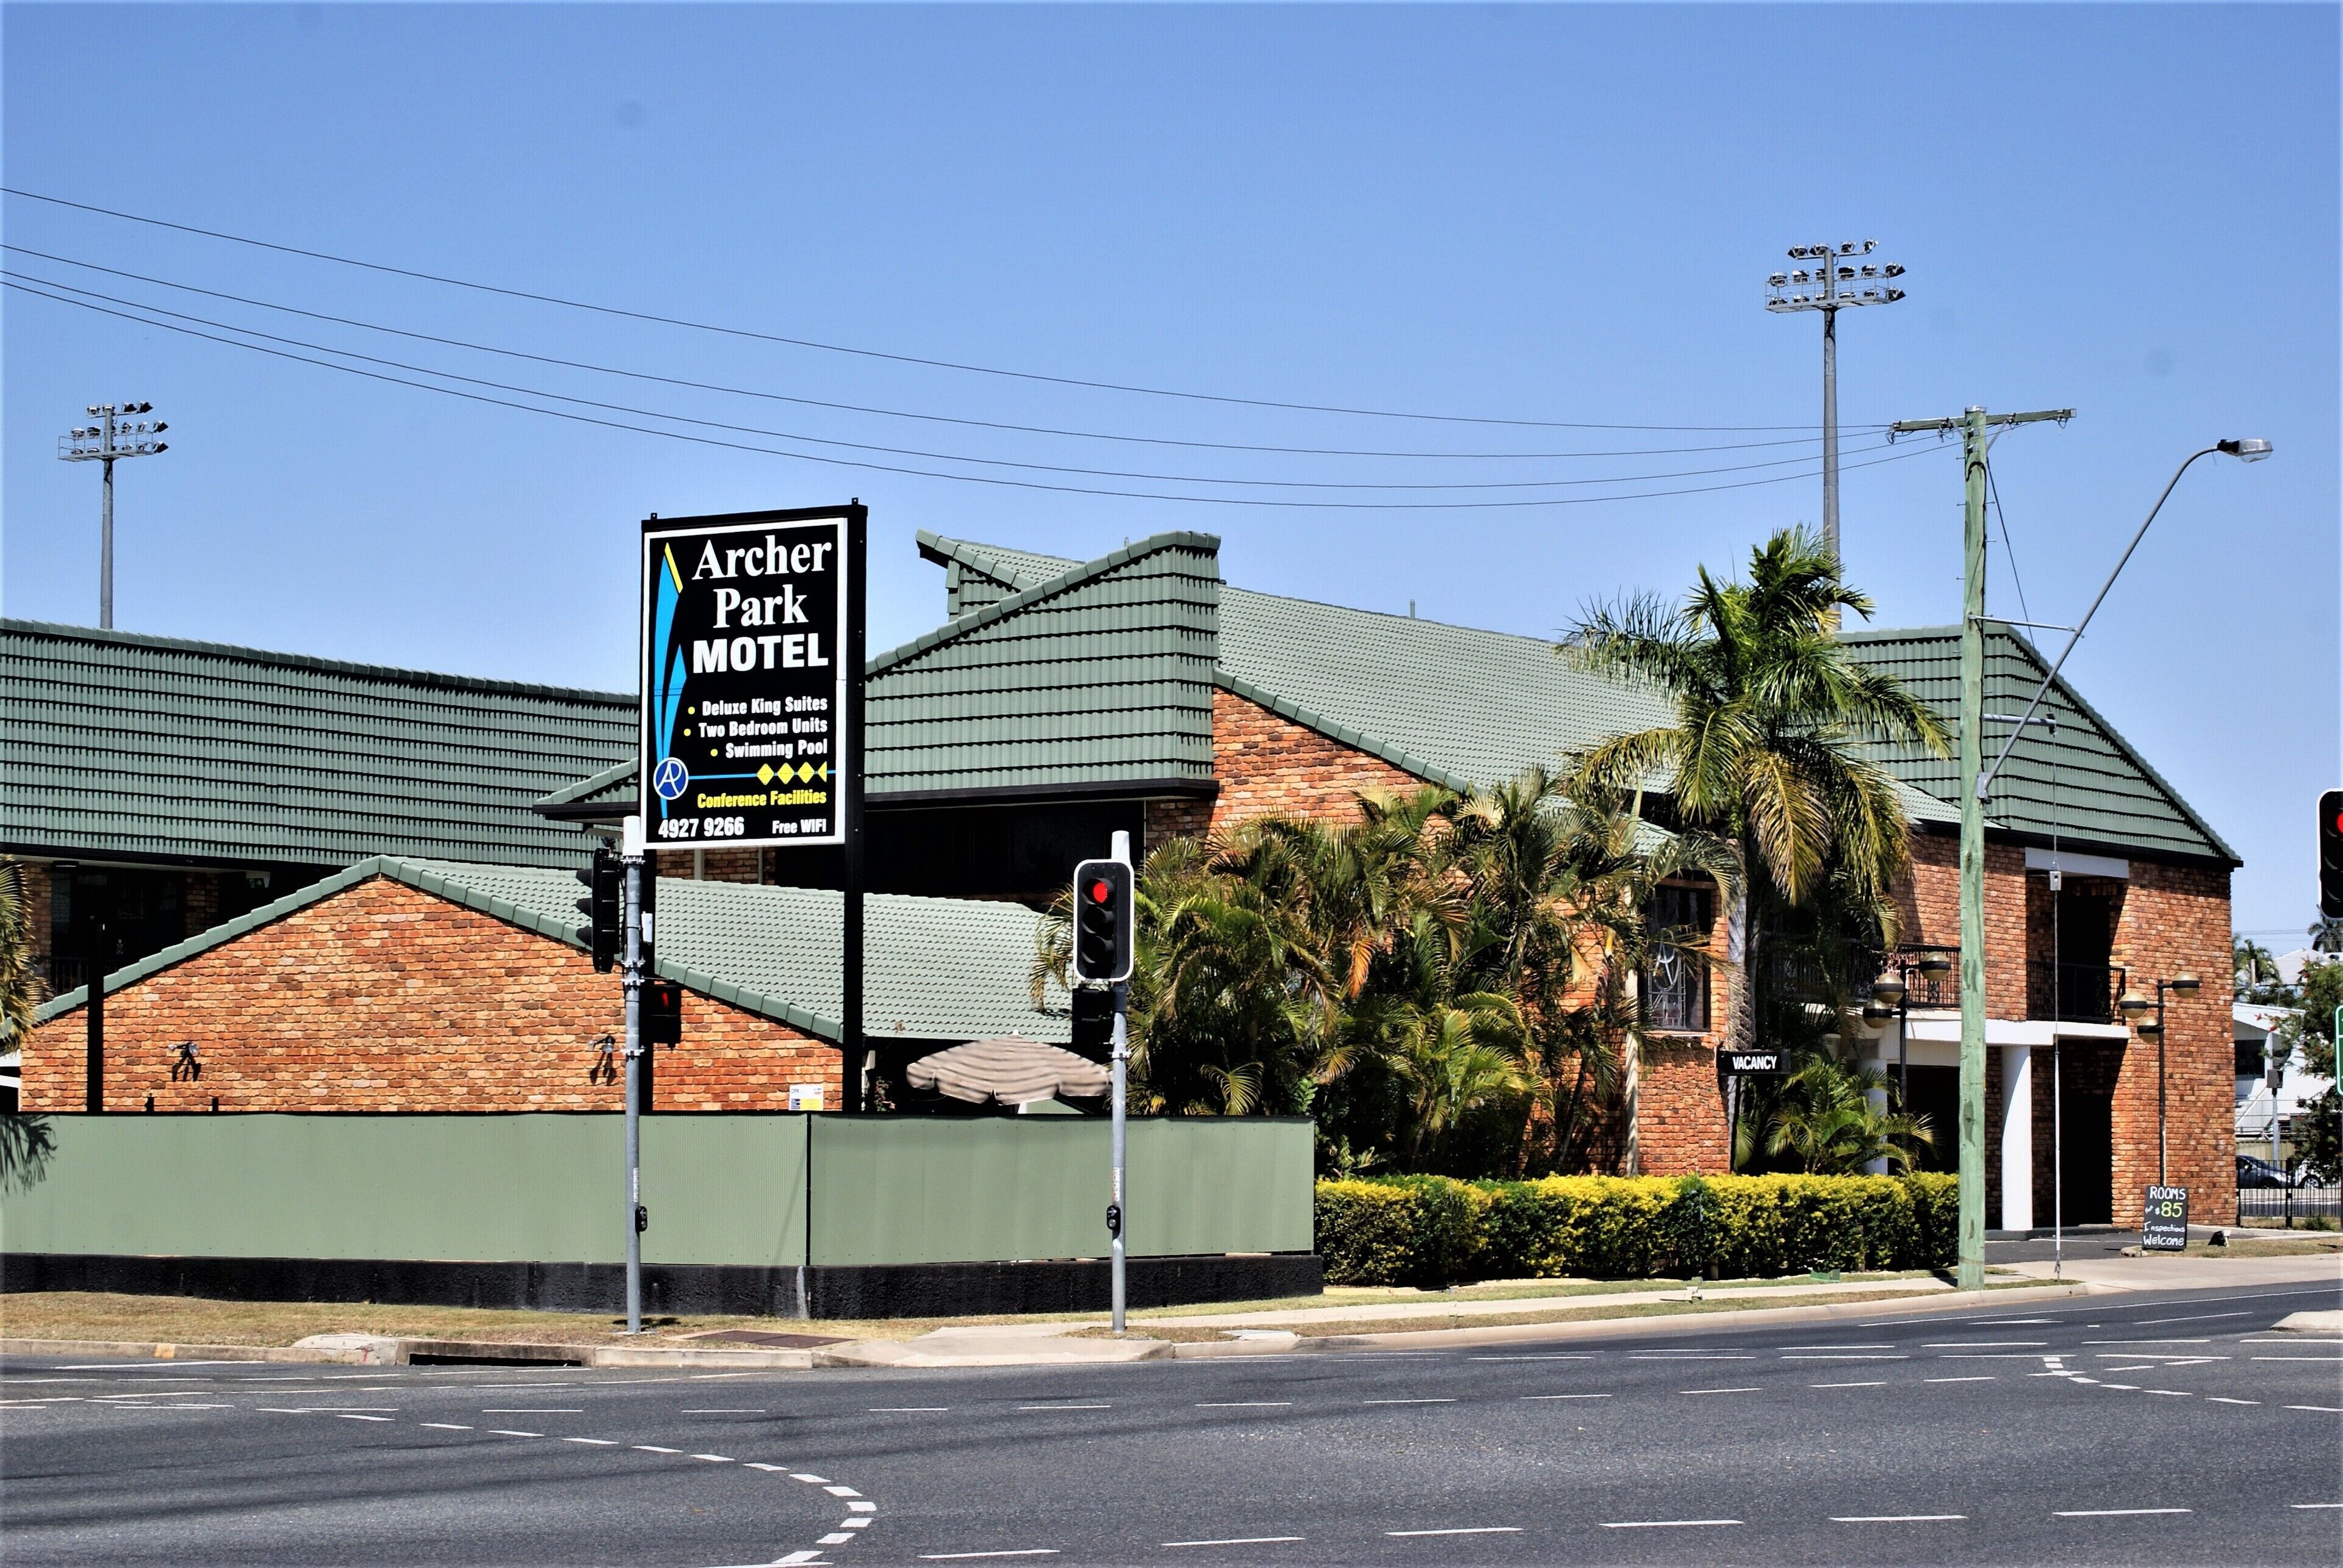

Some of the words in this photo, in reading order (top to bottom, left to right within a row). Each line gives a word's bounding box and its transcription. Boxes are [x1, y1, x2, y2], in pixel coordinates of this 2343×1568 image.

[691, 534, 832, 580] Archer
[713, 584, 809, 628] Park
[693, 633, 829, 674] MOTEL
[702, 700, 747, 716] Deluxe
[750, 698, 781, 716] King
[785, 696, 828, 712] Suites
[698, 722, 725, 738] Two
[729, 720, 788, 736] Bedroom
[792, 717, 828, 734] Units
[725, 741, 793, 759] Swimming
[797, 738, 828, 755] Pool
[697, 793, 767, 808] Conference
[770, 789, 827, 805] Facilities
[658, 818, 699, 838] 4927
[704, 816, 744, 836] 9266
[772, 820, 797, 834] Free
[1732, 1056, 1777, 1070] VACANCY
[2150, 1186, 2186, 1200] ROOMS
[2143, 1234, 2184, 1246] Welcome
